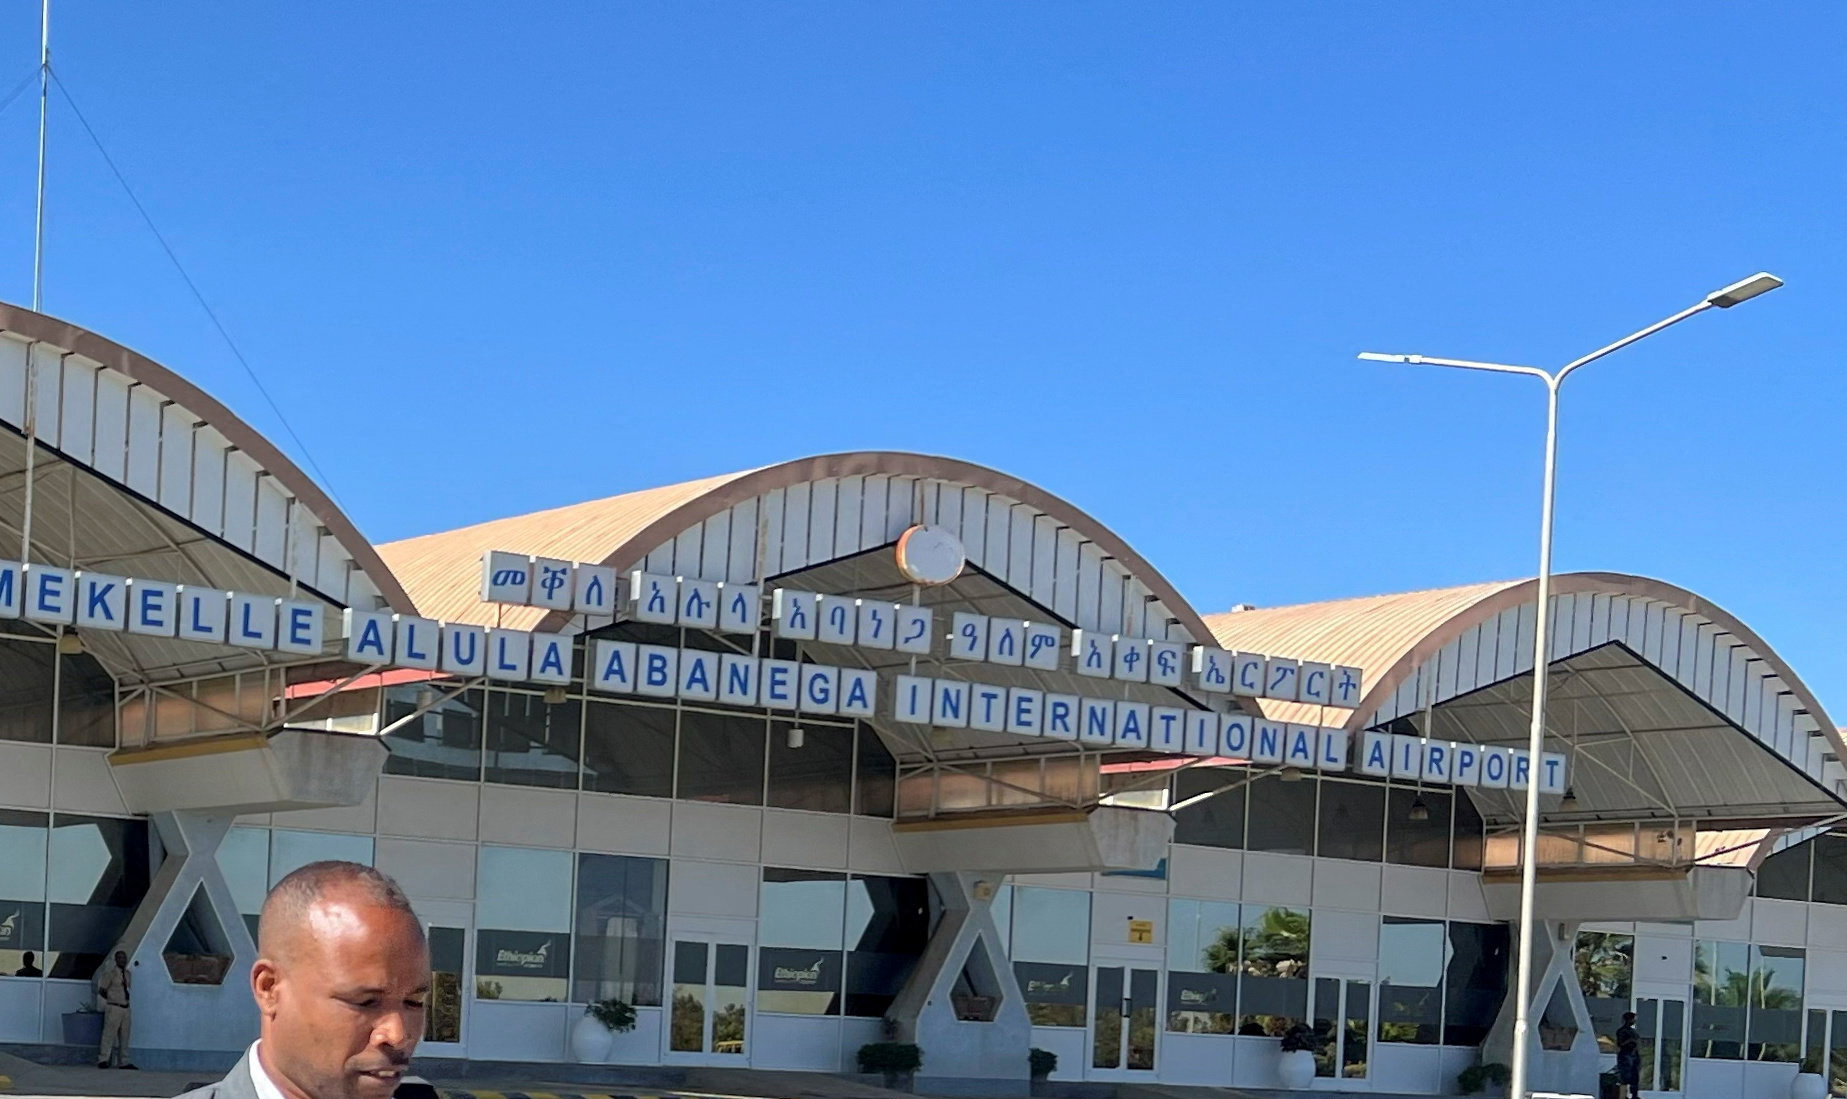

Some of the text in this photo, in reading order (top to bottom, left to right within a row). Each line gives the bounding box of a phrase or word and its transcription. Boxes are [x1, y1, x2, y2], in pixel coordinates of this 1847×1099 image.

[491, 566, 604, 606] መቐለ
[646, 581, 748, 623] አሉላ
[962, 623, 1056, 658] ዓለም
[1086, 640, 1176, 676] አቀፍ
[1205, 656, 1357, 700] ኤርፖርት
[357, 619, 564, 677] ALULA
[602, 649, 869, 710] ABANEGA
[909, 682, 1340, 763] INTERNATIONAL
[1367, 740, 1559, 787] AIRPORT
[496, 949, 545, 966] Ethiopian
